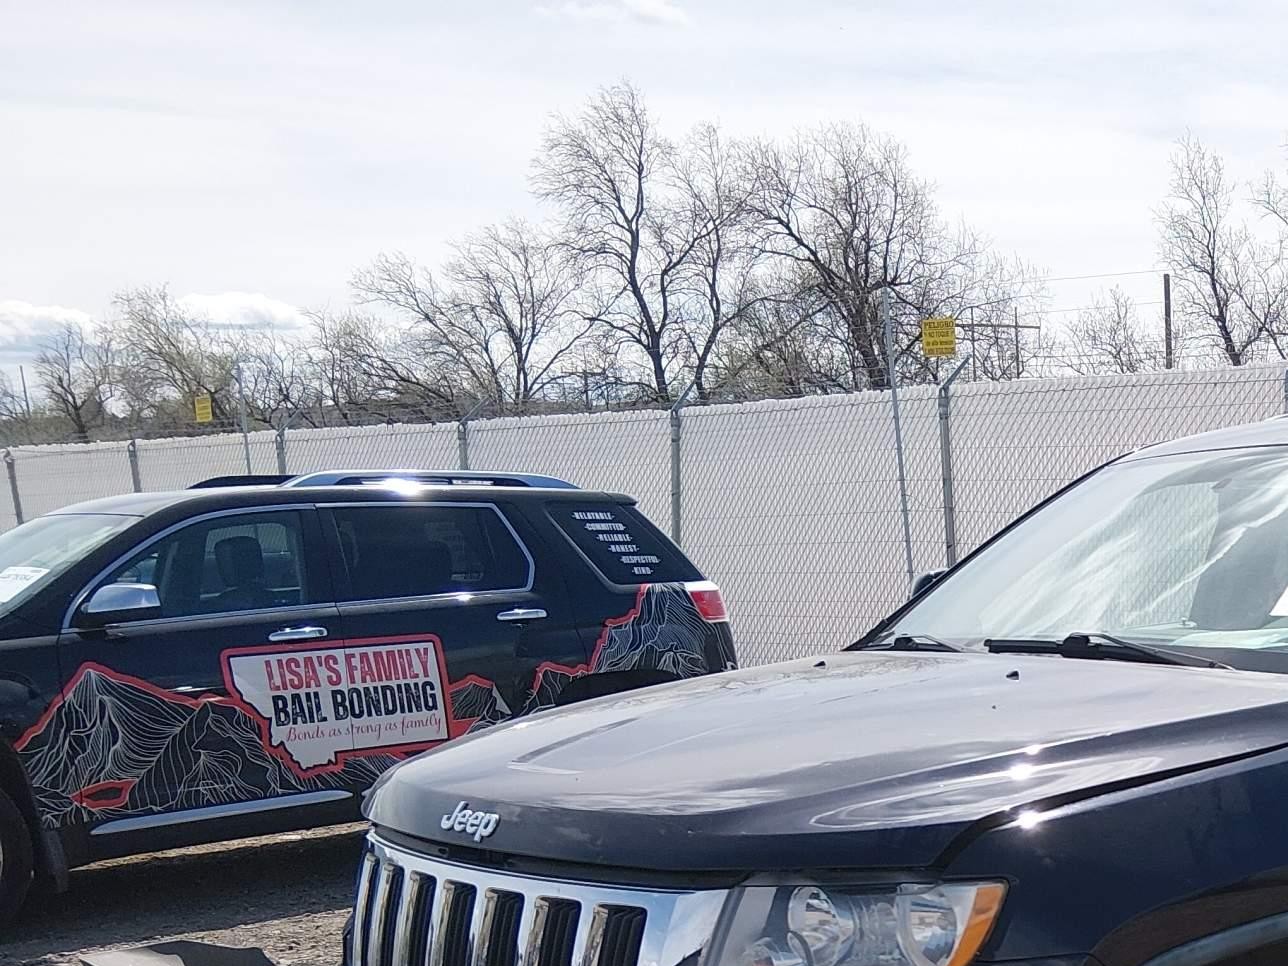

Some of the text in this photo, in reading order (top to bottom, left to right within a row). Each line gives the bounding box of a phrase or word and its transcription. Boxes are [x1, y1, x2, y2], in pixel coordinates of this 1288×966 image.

[264, 647, 430, 692] LISA'S FAMILY
[271, 681, 439, 727] BAIL BONDING
[286, 713, 442, 742] Bonds as strong as family
[440, 800, 499, 842] Jeep
